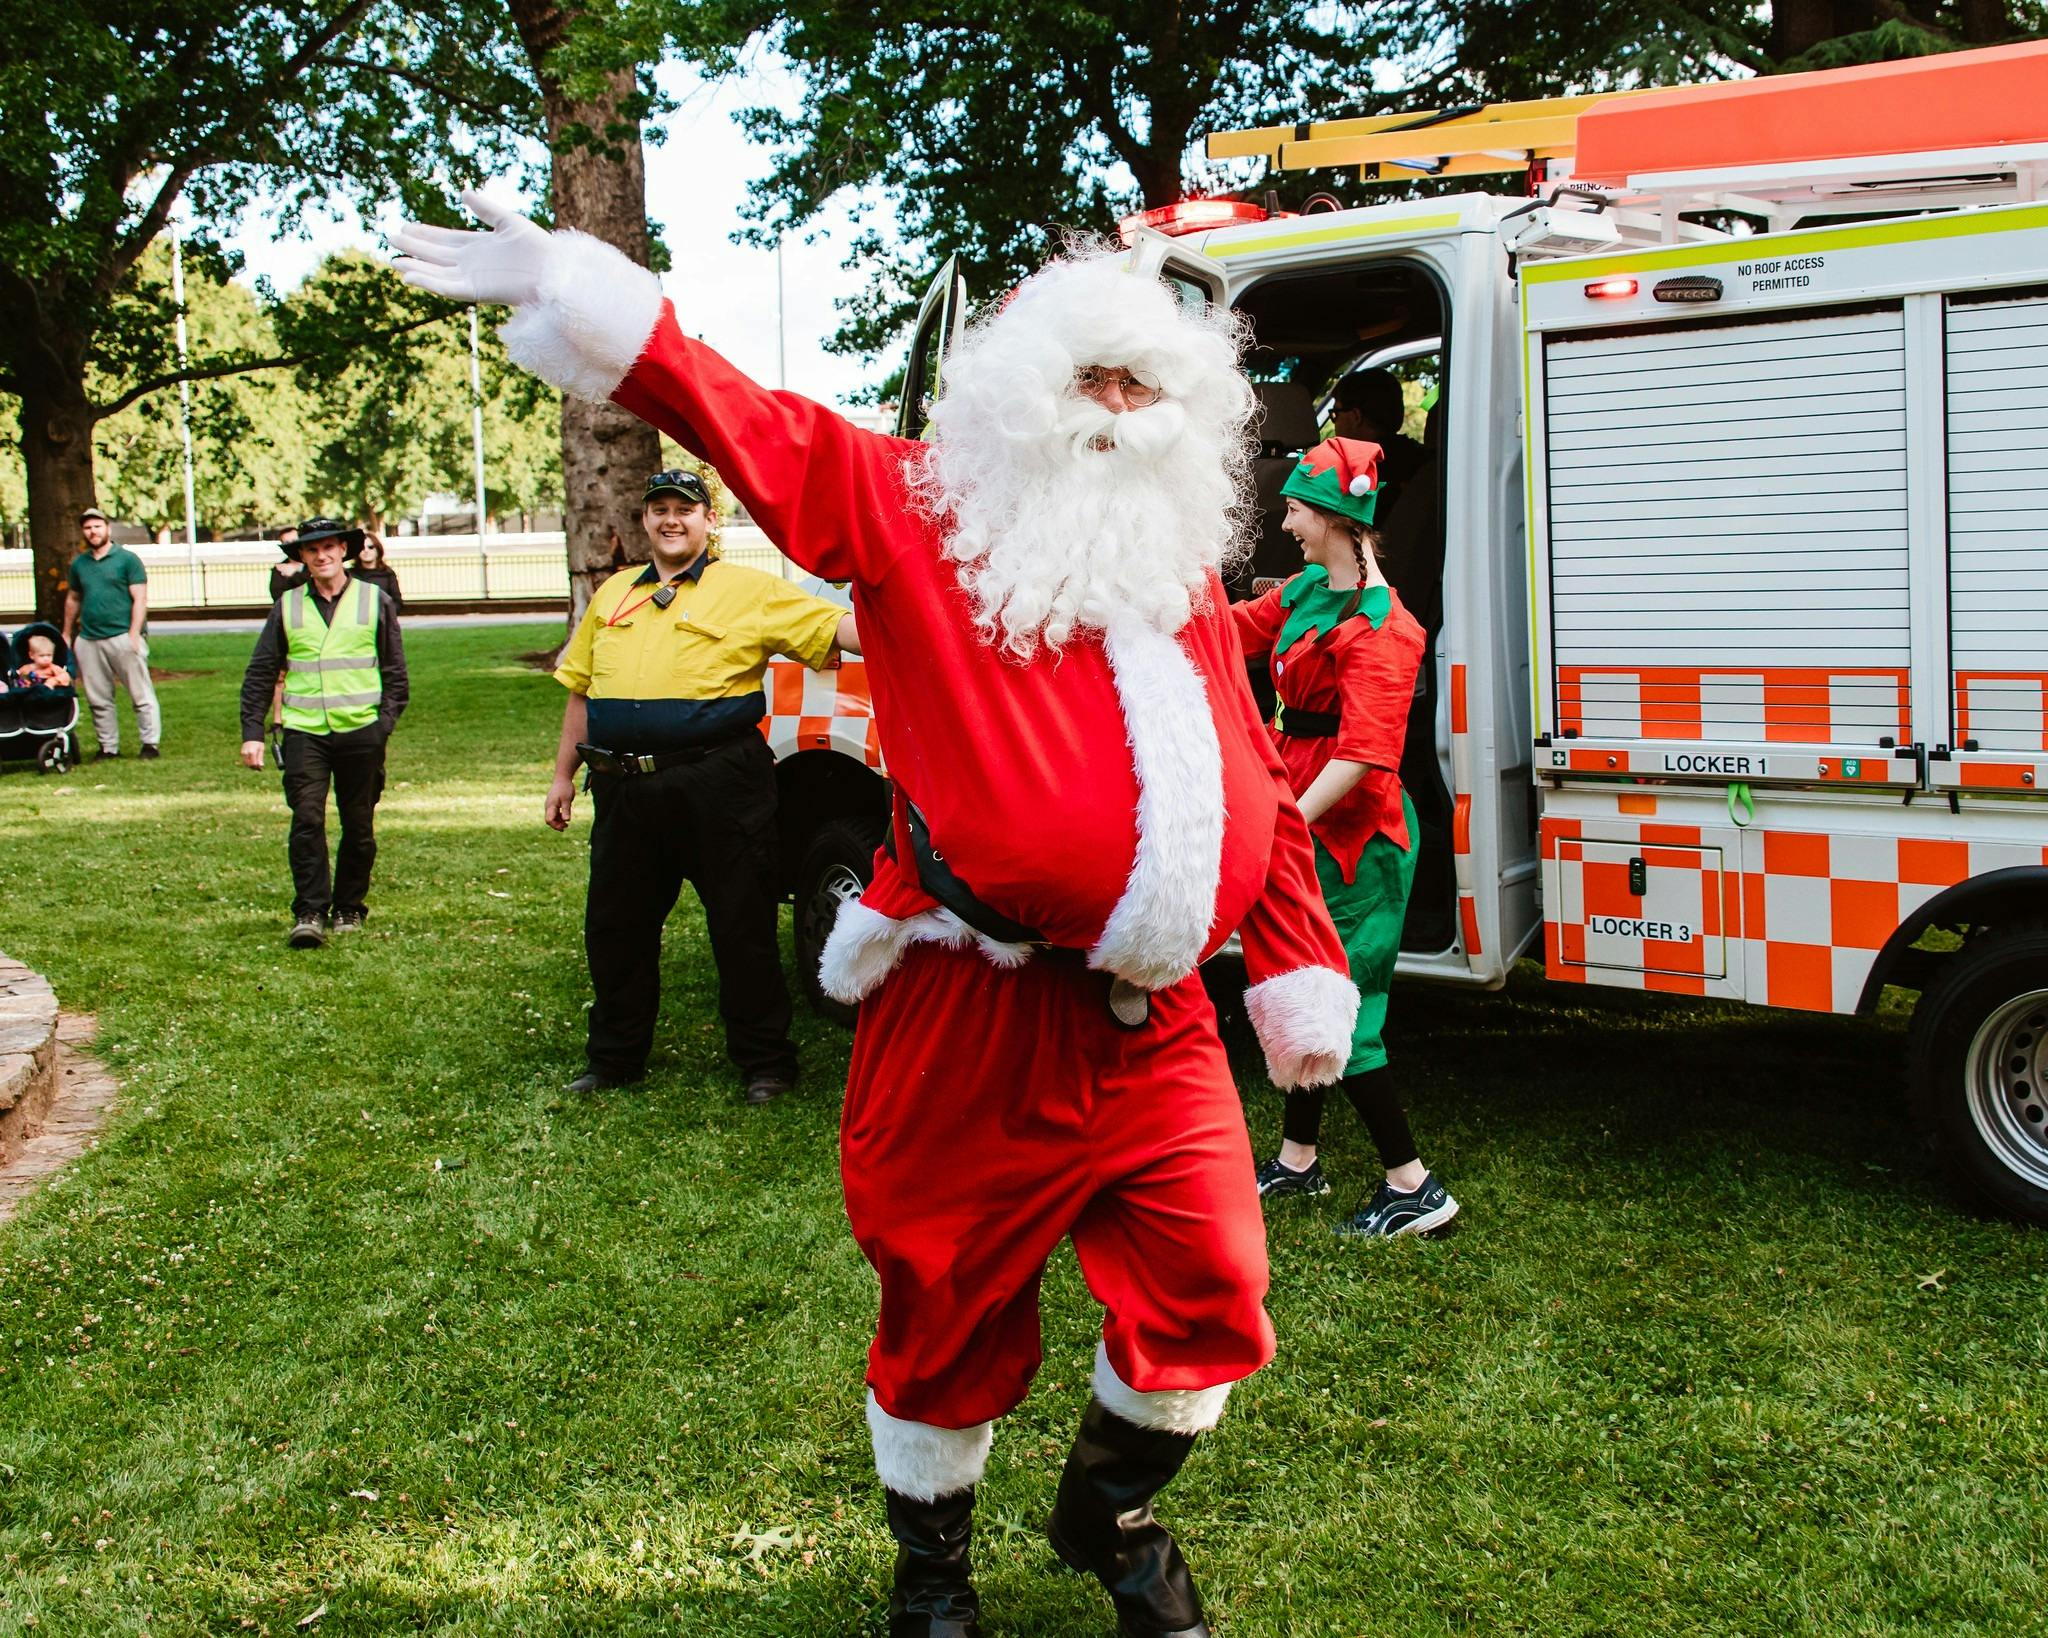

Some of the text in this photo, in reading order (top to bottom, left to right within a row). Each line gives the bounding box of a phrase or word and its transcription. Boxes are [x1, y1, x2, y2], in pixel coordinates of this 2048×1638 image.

[1738, 256, 1824, 276] NO ROOF ACCESS
[1752, 275, 1810, 292] PERMITTED
[1665, 754, 1766, 775] LOCKER 1
[1592, 917, 1690, 941] LOCKER 3
